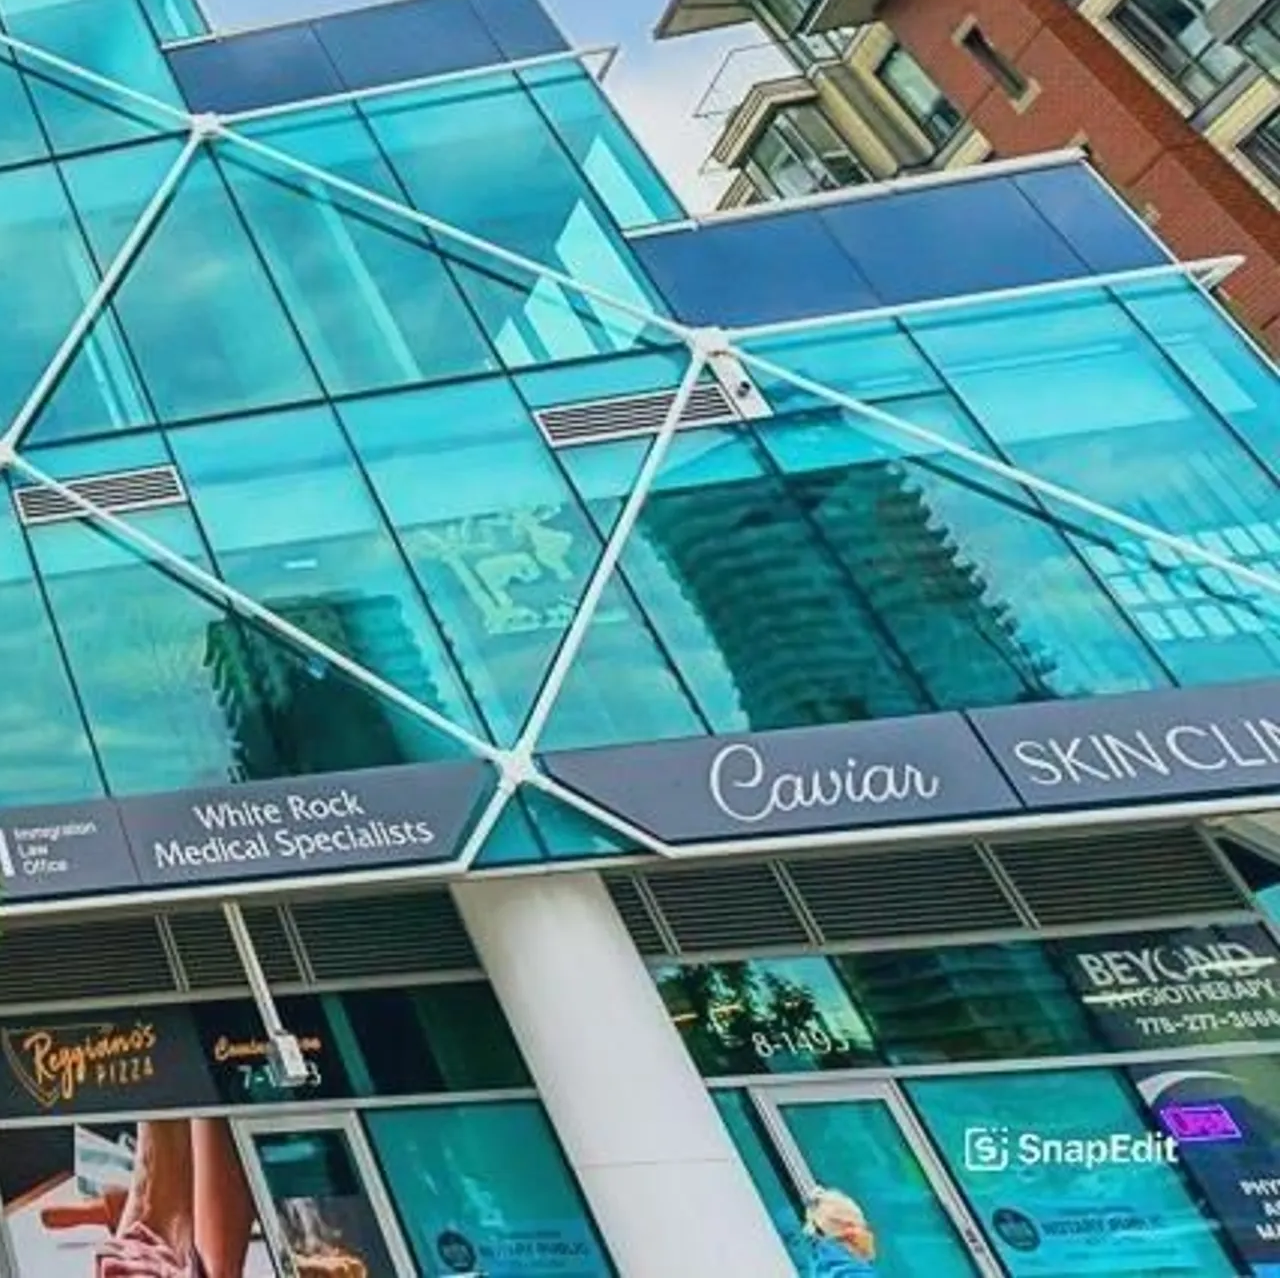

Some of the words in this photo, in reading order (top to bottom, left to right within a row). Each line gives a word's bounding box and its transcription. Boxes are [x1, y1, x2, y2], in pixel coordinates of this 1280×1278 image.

[1014, 730, 1171, 786] SKIN
[710, 743, 940, 822] Caviar
[193, 800, 282, 830] White
[287, 789, 366, 821] Rock
[17, 843, 48, 859] Law
[153, 833, 270, 869] Medical
[275, 820, 435, 860] Specialists
[23, 859, 70, 874] Office
[96, 1055, 155, 1088] PIZZA
